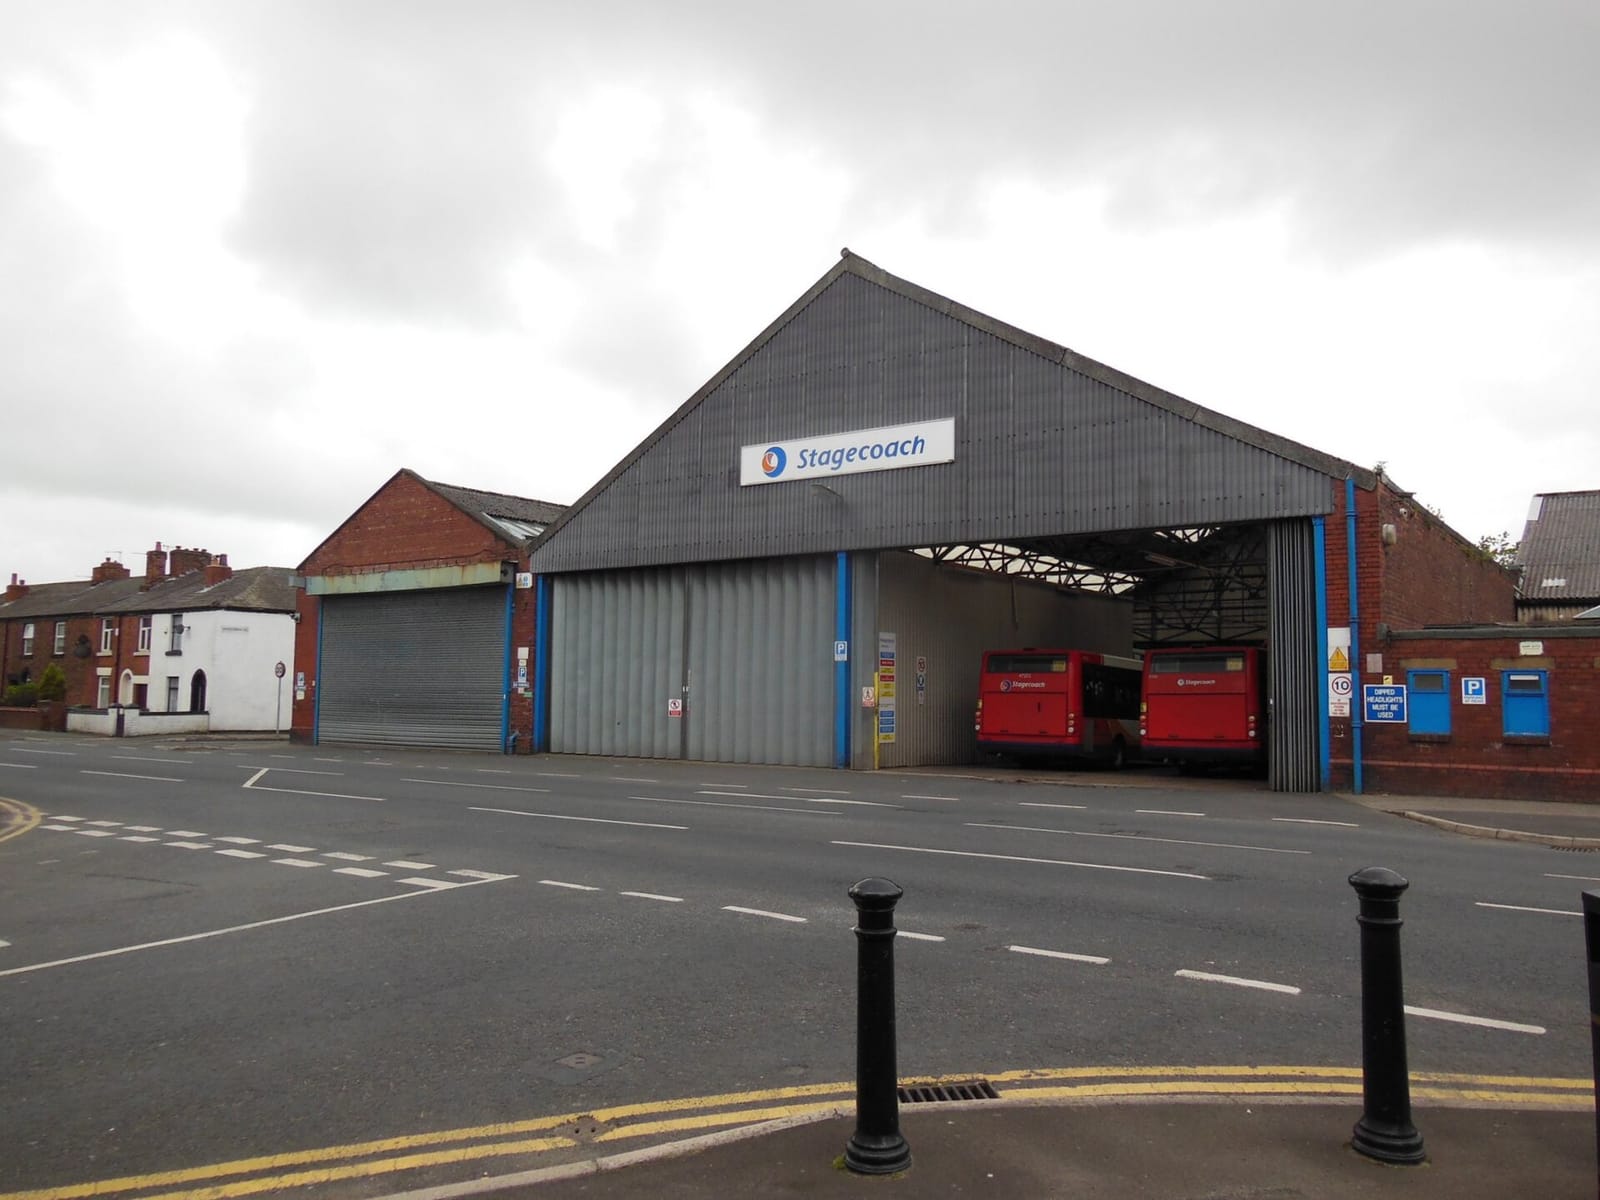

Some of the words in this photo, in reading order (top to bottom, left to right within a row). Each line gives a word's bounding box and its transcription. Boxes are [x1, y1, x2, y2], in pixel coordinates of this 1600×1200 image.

[797, 435, 926, 470] Stagecoach
[1012, 681, 1046, 689] Stagecoach
[1185, 679, 1216, 687] Stagecoach
[1334, 680, 1350, 691] 10
[1374, 688, 1395, 696] DIPPED
[1468, 681, 1480, 695] P
[1367, 696, 1404, 704] HEADLIGHTS
[1377, 711, 1394, 719] USED
